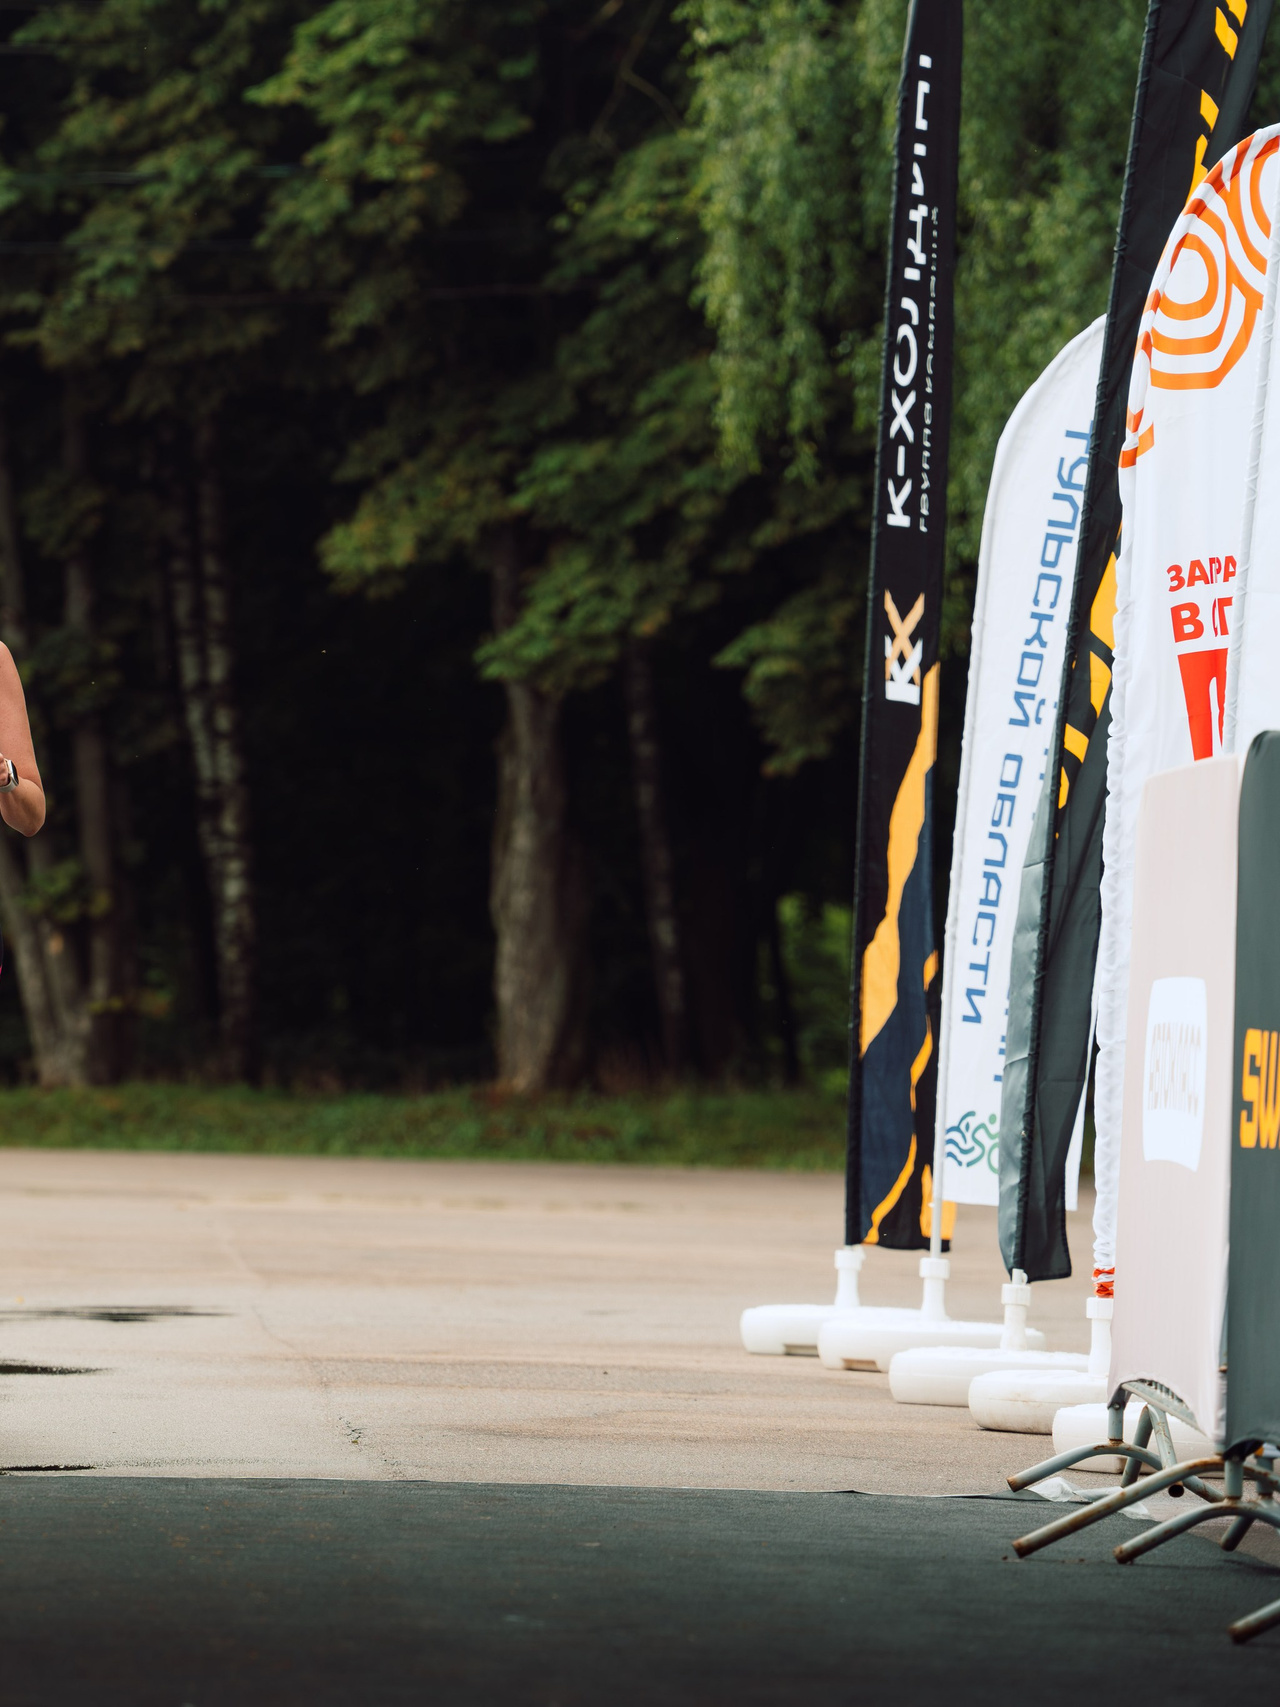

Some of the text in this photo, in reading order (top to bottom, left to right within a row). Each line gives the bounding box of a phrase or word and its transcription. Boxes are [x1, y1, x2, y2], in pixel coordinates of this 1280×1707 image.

[886, 54, 932, 528] К-ХОЛДИН
[961, 420, 1094, 1025] ТУЛЬСКОЙ ОБЛАСТИ
[1239, 1028, 1280, 1150] SW
